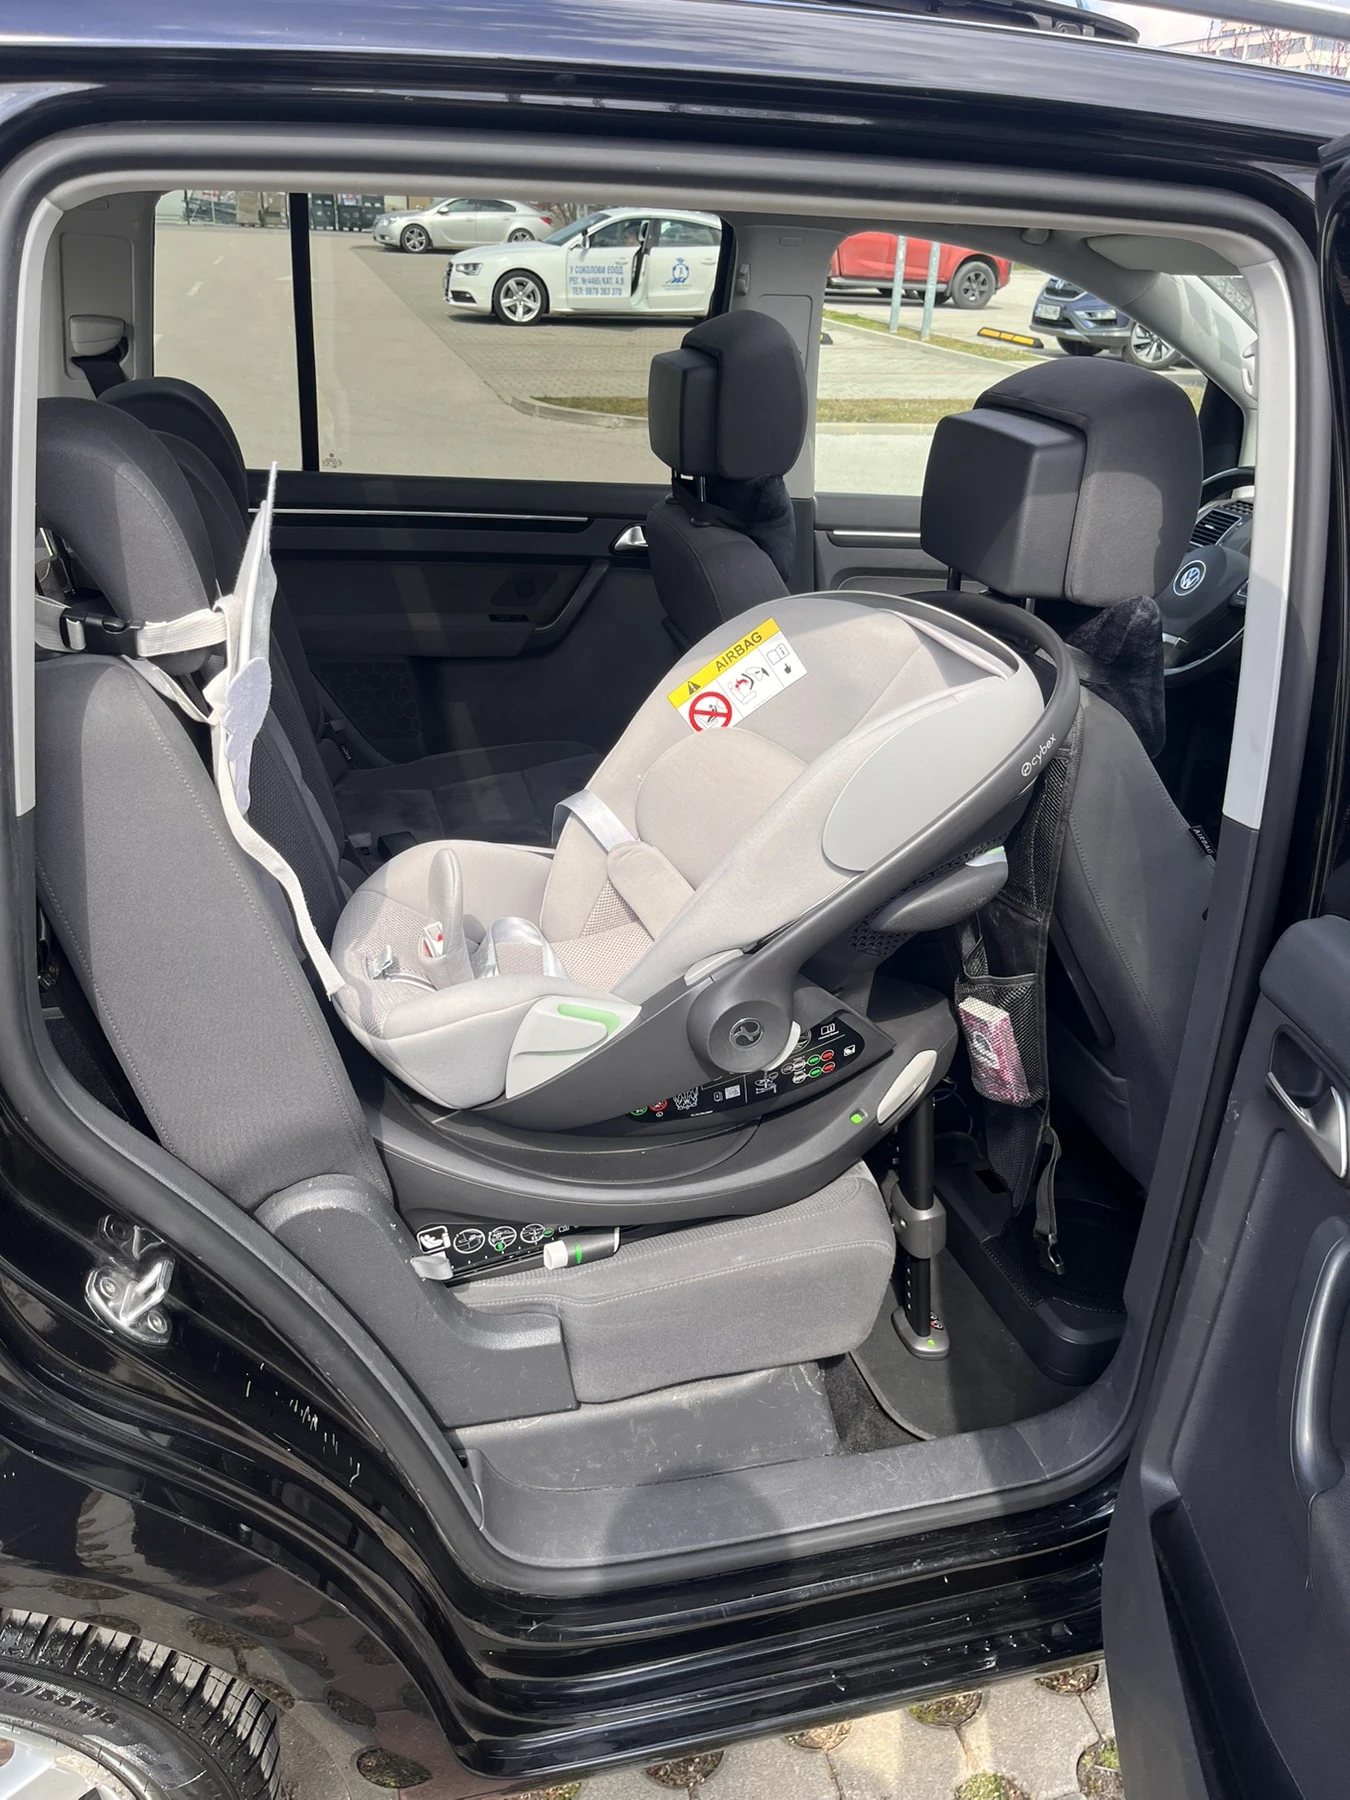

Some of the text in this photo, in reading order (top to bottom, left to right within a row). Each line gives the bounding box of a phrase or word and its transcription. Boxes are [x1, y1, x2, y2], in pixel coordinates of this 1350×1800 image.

[715, 631, 763, 672] AIRBAG
[1031, 733, 1057, 765] cybex
[1192, 828, 1214, 854] AIRBAG
